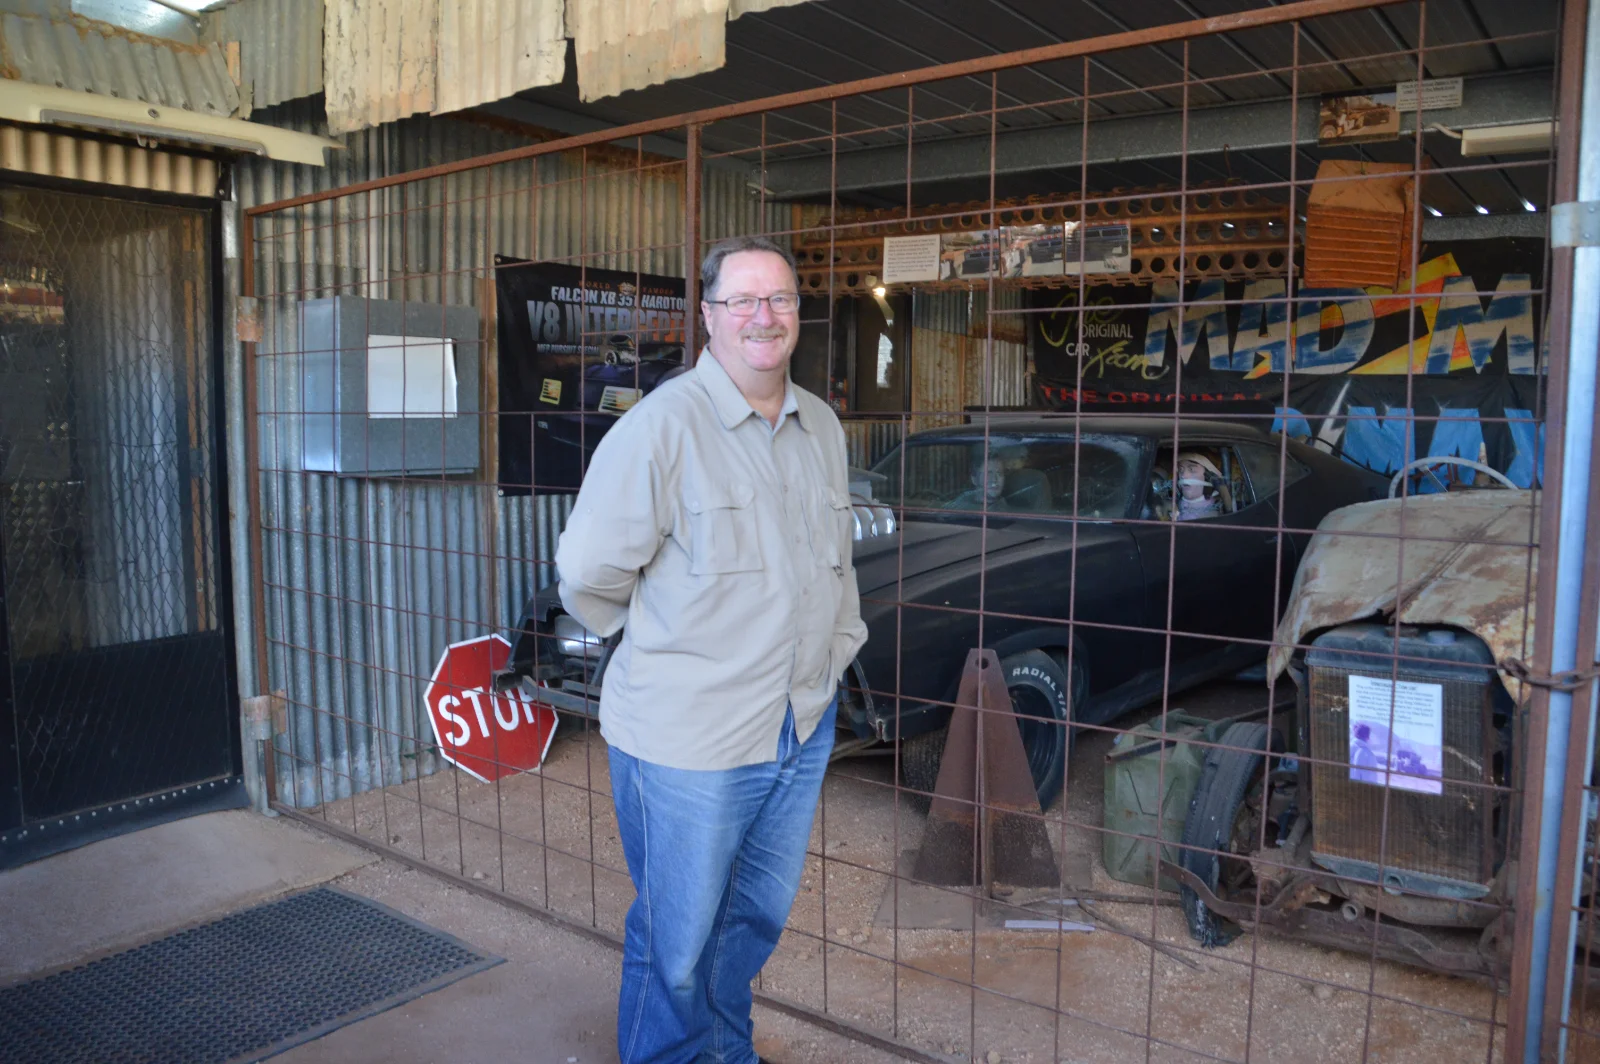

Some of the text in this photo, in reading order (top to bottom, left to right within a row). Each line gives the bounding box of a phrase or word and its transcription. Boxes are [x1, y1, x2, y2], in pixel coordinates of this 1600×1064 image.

[551, 286, 598, 305] FALCON
[600, 290, 617, 306] XB
[618, 293, 639, 307] 351
[527, 300, 711, 347] V8 INTERCEPTR
[1080, 323, 1134, 339] ORIGINAL
[1144, 277, 1376, 375] MAD
[1065, 342, 1090, 357] CAR
[1040, 384, 1099, 403] THE
[1012, 667, 1056, 690] RADIAL
